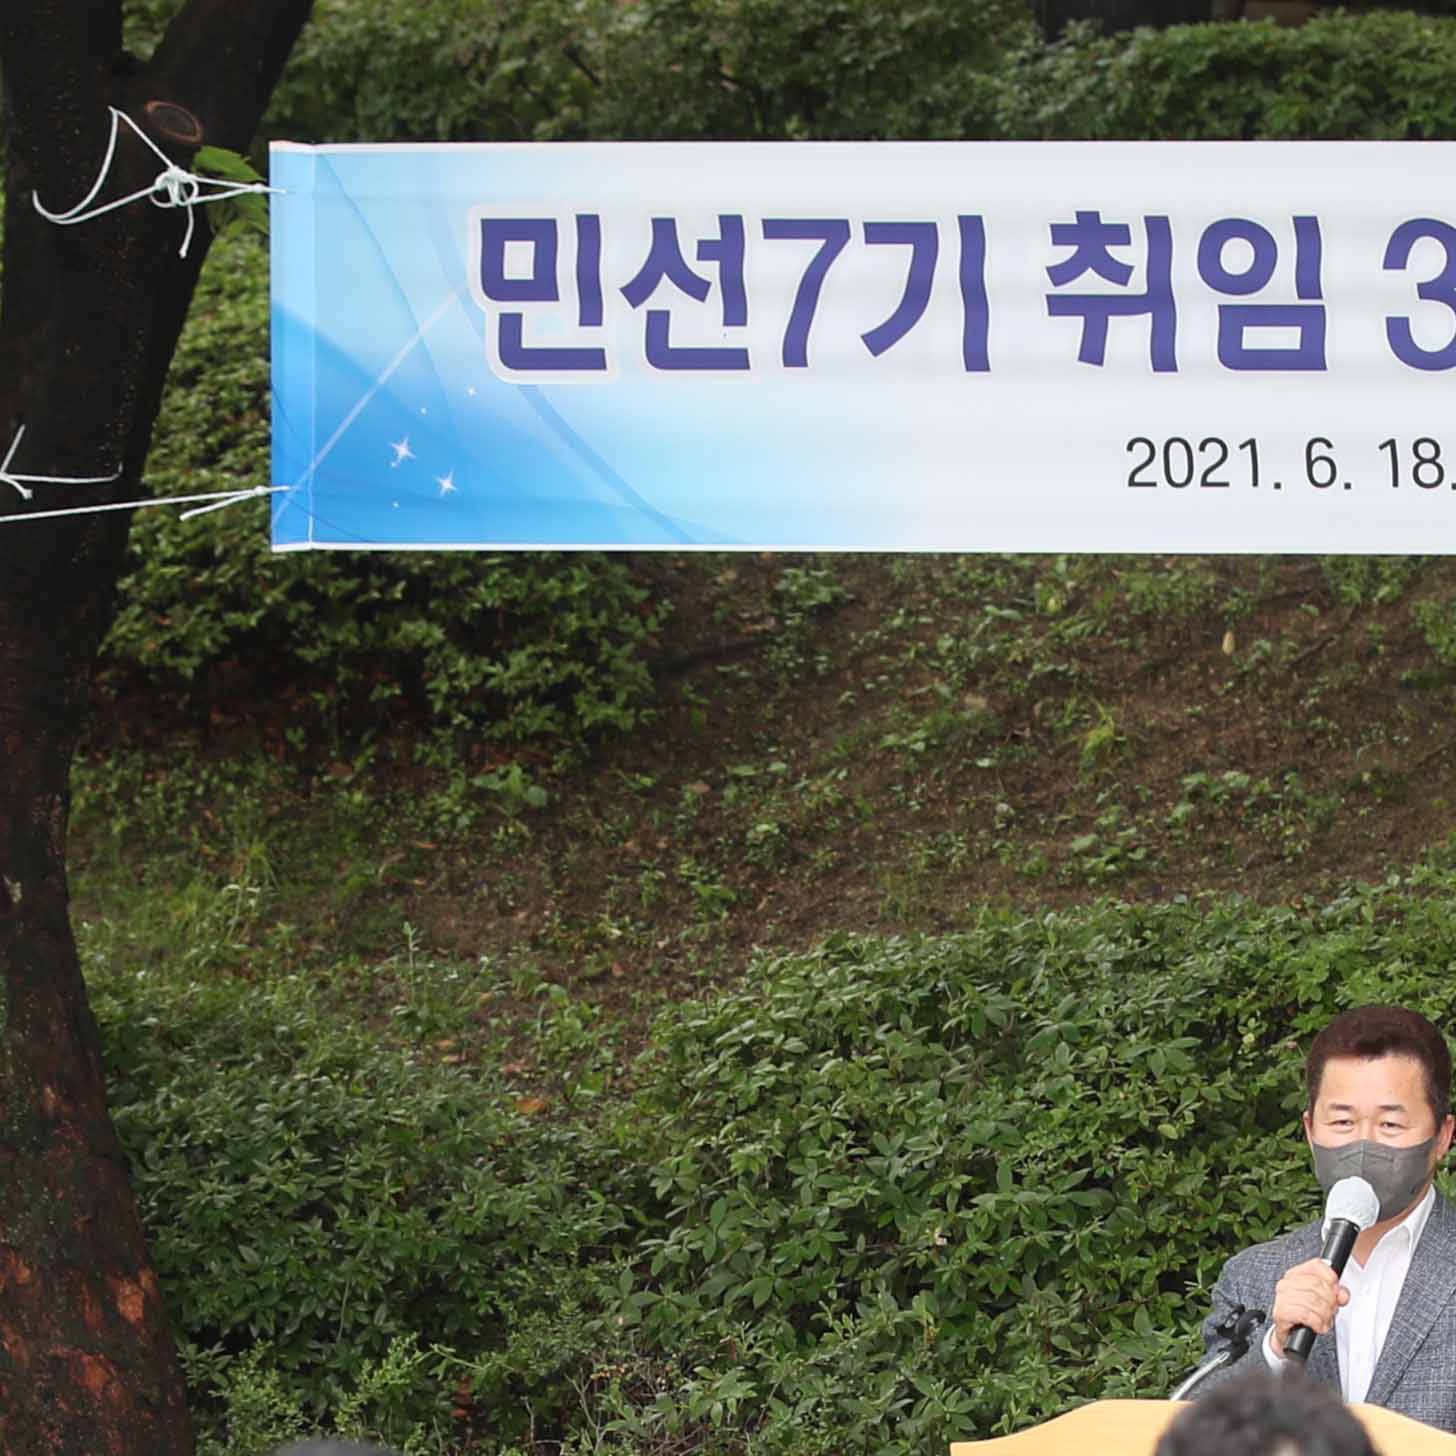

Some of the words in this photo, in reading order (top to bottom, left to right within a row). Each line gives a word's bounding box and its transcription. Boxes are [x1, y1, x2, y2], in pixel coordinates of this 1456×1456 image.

[480, 213, 992, 373] 민선7기
[1045, 211, 1328, 374] 취임
[1126, 436, 1283, 490] 2021.
[1305, 436, 1352, 490] 6.
